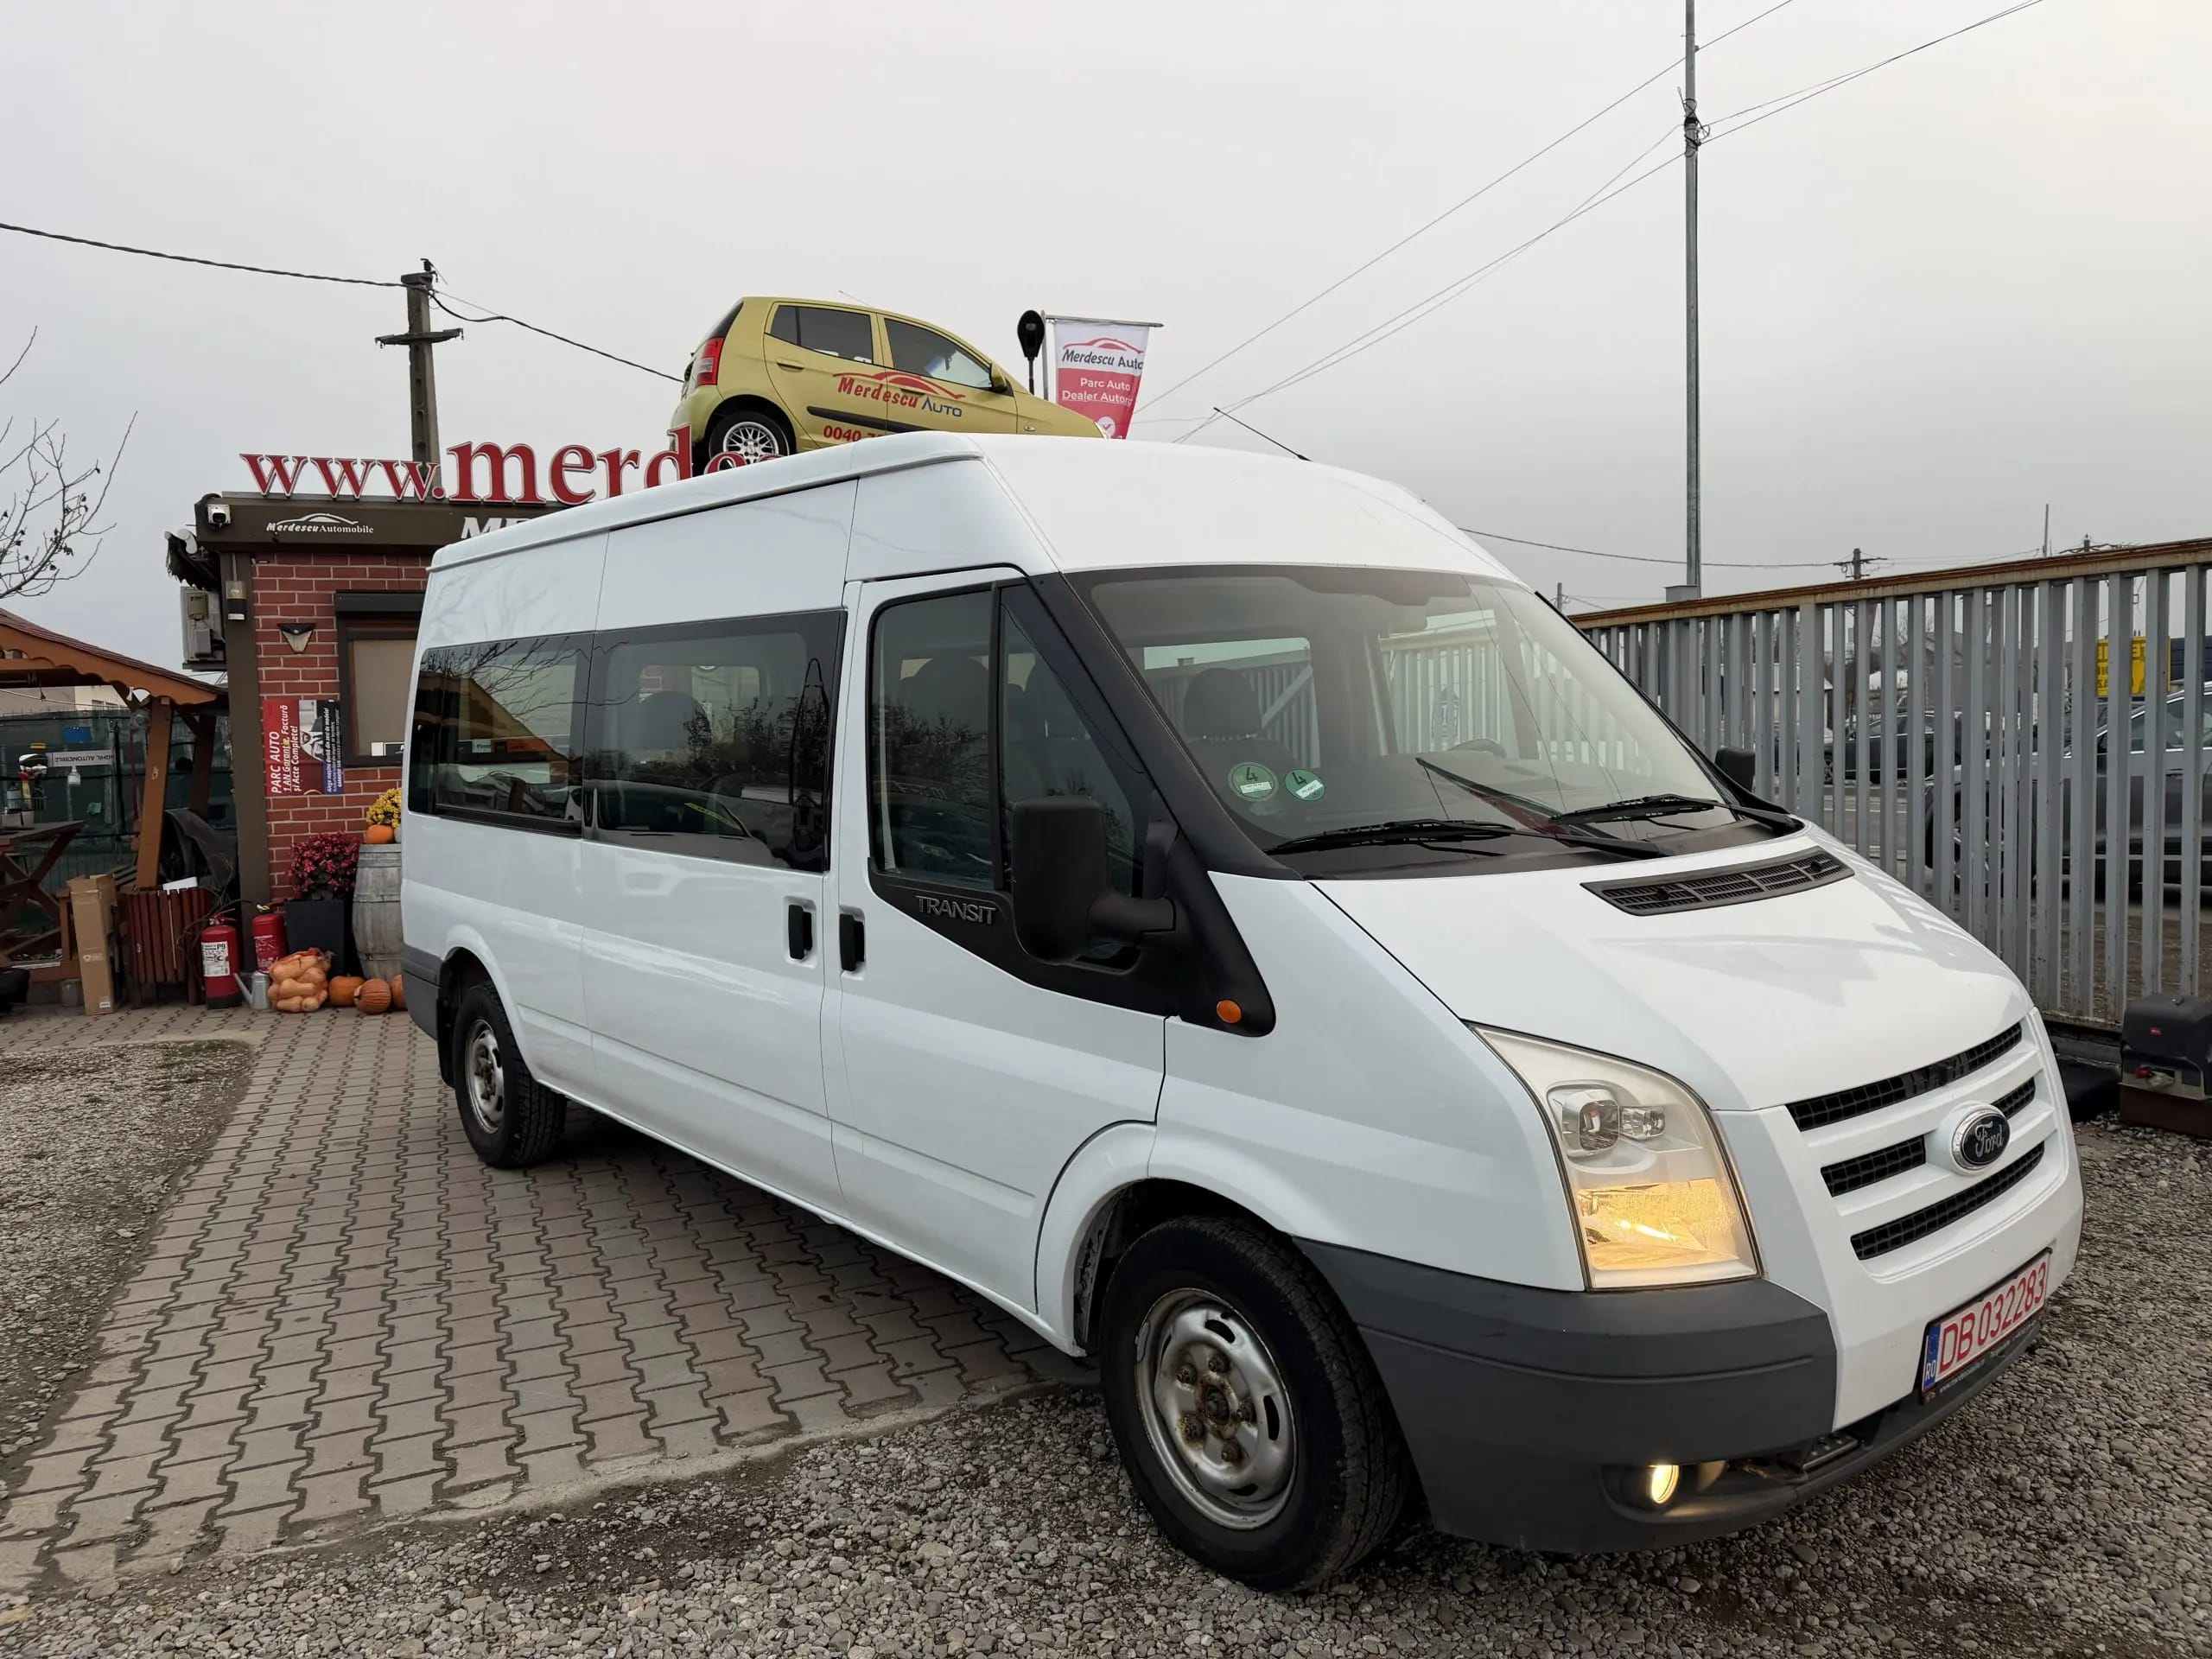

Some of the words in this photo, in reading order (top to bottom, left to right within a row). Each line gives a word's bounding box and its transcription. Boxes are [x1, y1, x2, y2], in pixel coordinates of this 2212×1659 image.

[1061, 348, 1116, 366] Merdescu
[837, 377, 918, 409] Merdescu
[1062, 391, 1098, 401] Dealer
[1080, 378, 1105, 388] Parc
[1106, 380, 1131, 391] Auto
[266, 522, 319, 533] Merdescu
[319, 524, 374, 534] Automobile
[280, 704, 289, 734] Factură
[269, 731, 280, 762] AUTO
[290, 726, 301, 765] Complete!
[270, 765, 282, 793] PARC
[283, 772, 291, 785] AN
[291, 766, 300, 783] Acte
[916, 895, 996, 925] TRANSIT
[1974, 1120, 2005, 1158] Ford
[1925, 1360, 1936, 1382] RO
